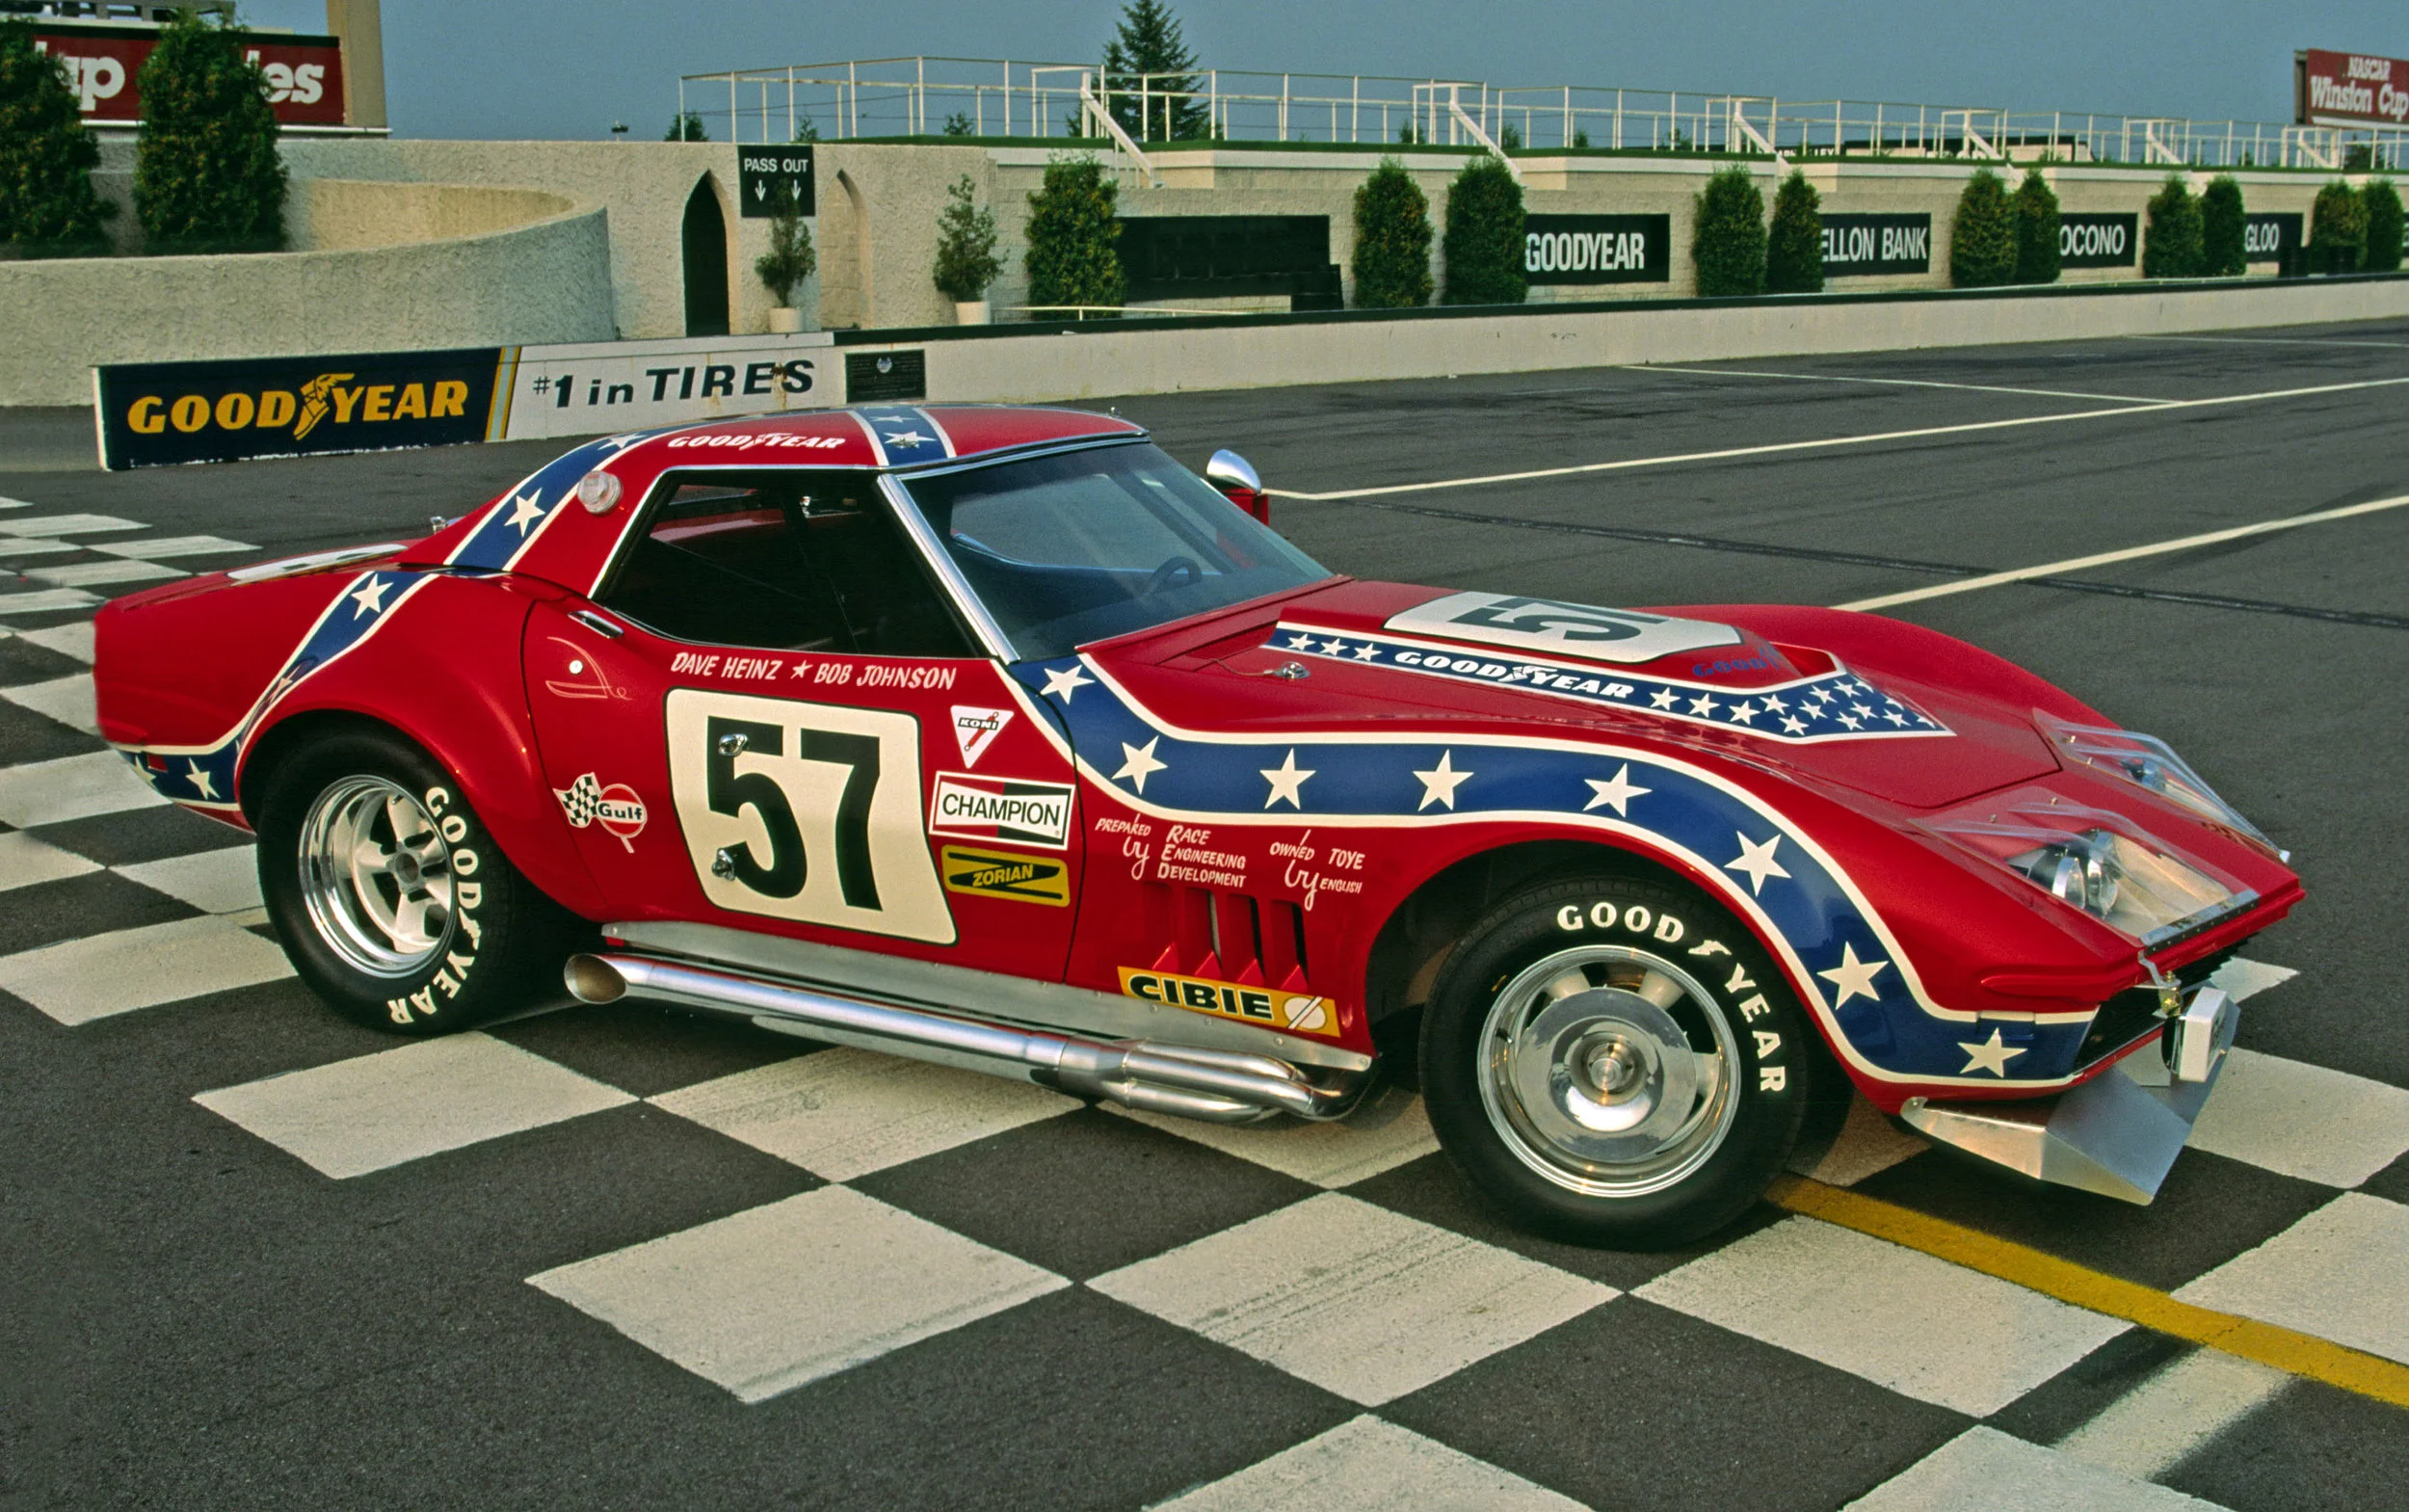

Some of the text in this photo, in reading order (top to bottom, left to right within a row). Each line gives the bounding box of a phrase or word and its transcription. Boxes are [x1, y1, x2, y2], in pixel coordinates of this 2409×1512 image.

[2347, 56, 2391, 81] NASCAR
[2311, 75, 2408, 122] Winston Cup
[744, 158, 808, 172] PASS OUT
[1525, 232, 1645, 272] GOODYEAR
[1881, 226, 1928, 260] BANK
[588, 379, 634, 406] in
[646, 359, 815, 402] TIRES
[127, 378, 469, 439] GOODYEAR
[667, 434, 846, 450] GOODYEAR
[671, 652, 957, 691] DAVE HEINZ BOB JOHNSON
[1394, 651, 1634, 700] GOODYEAR
[597, 803, 643, 820] Gulf
[705, 716, 883, 911] 57
[941, 793, 1061, 828] CHAMPION
[971, 863, 1034, 888] ZORIAN
[1328, 848, 1365, 870] TOYE
[387, 786, 482, 1024] GOODYEAR
[1319, 877, 1363, 894] ENGLISH
[1128, 973, 1275, 1021] CIBIE
[1557, 902, 1787, 1093] GOODYEAR
